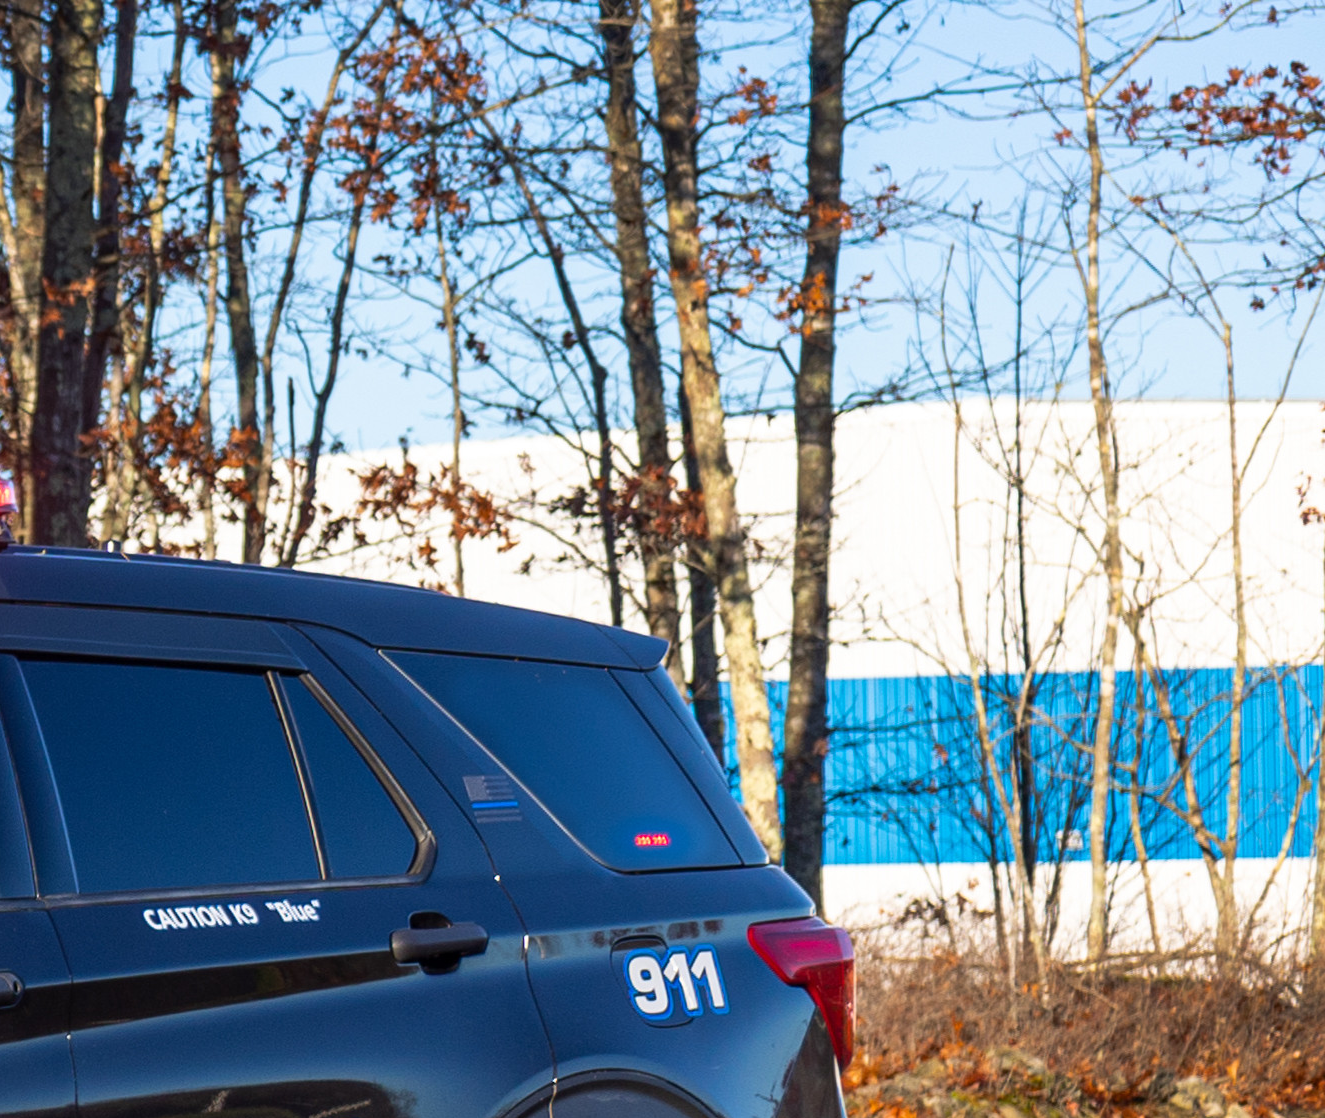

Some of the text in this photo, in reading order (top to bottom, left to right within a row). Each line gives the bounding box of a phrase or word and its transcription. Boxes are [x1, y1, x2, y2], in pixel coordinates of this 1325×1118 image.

[143, 900, 320, 930] CAUTION K9 "Blue"
[627, 948, 727, 1017] 911
